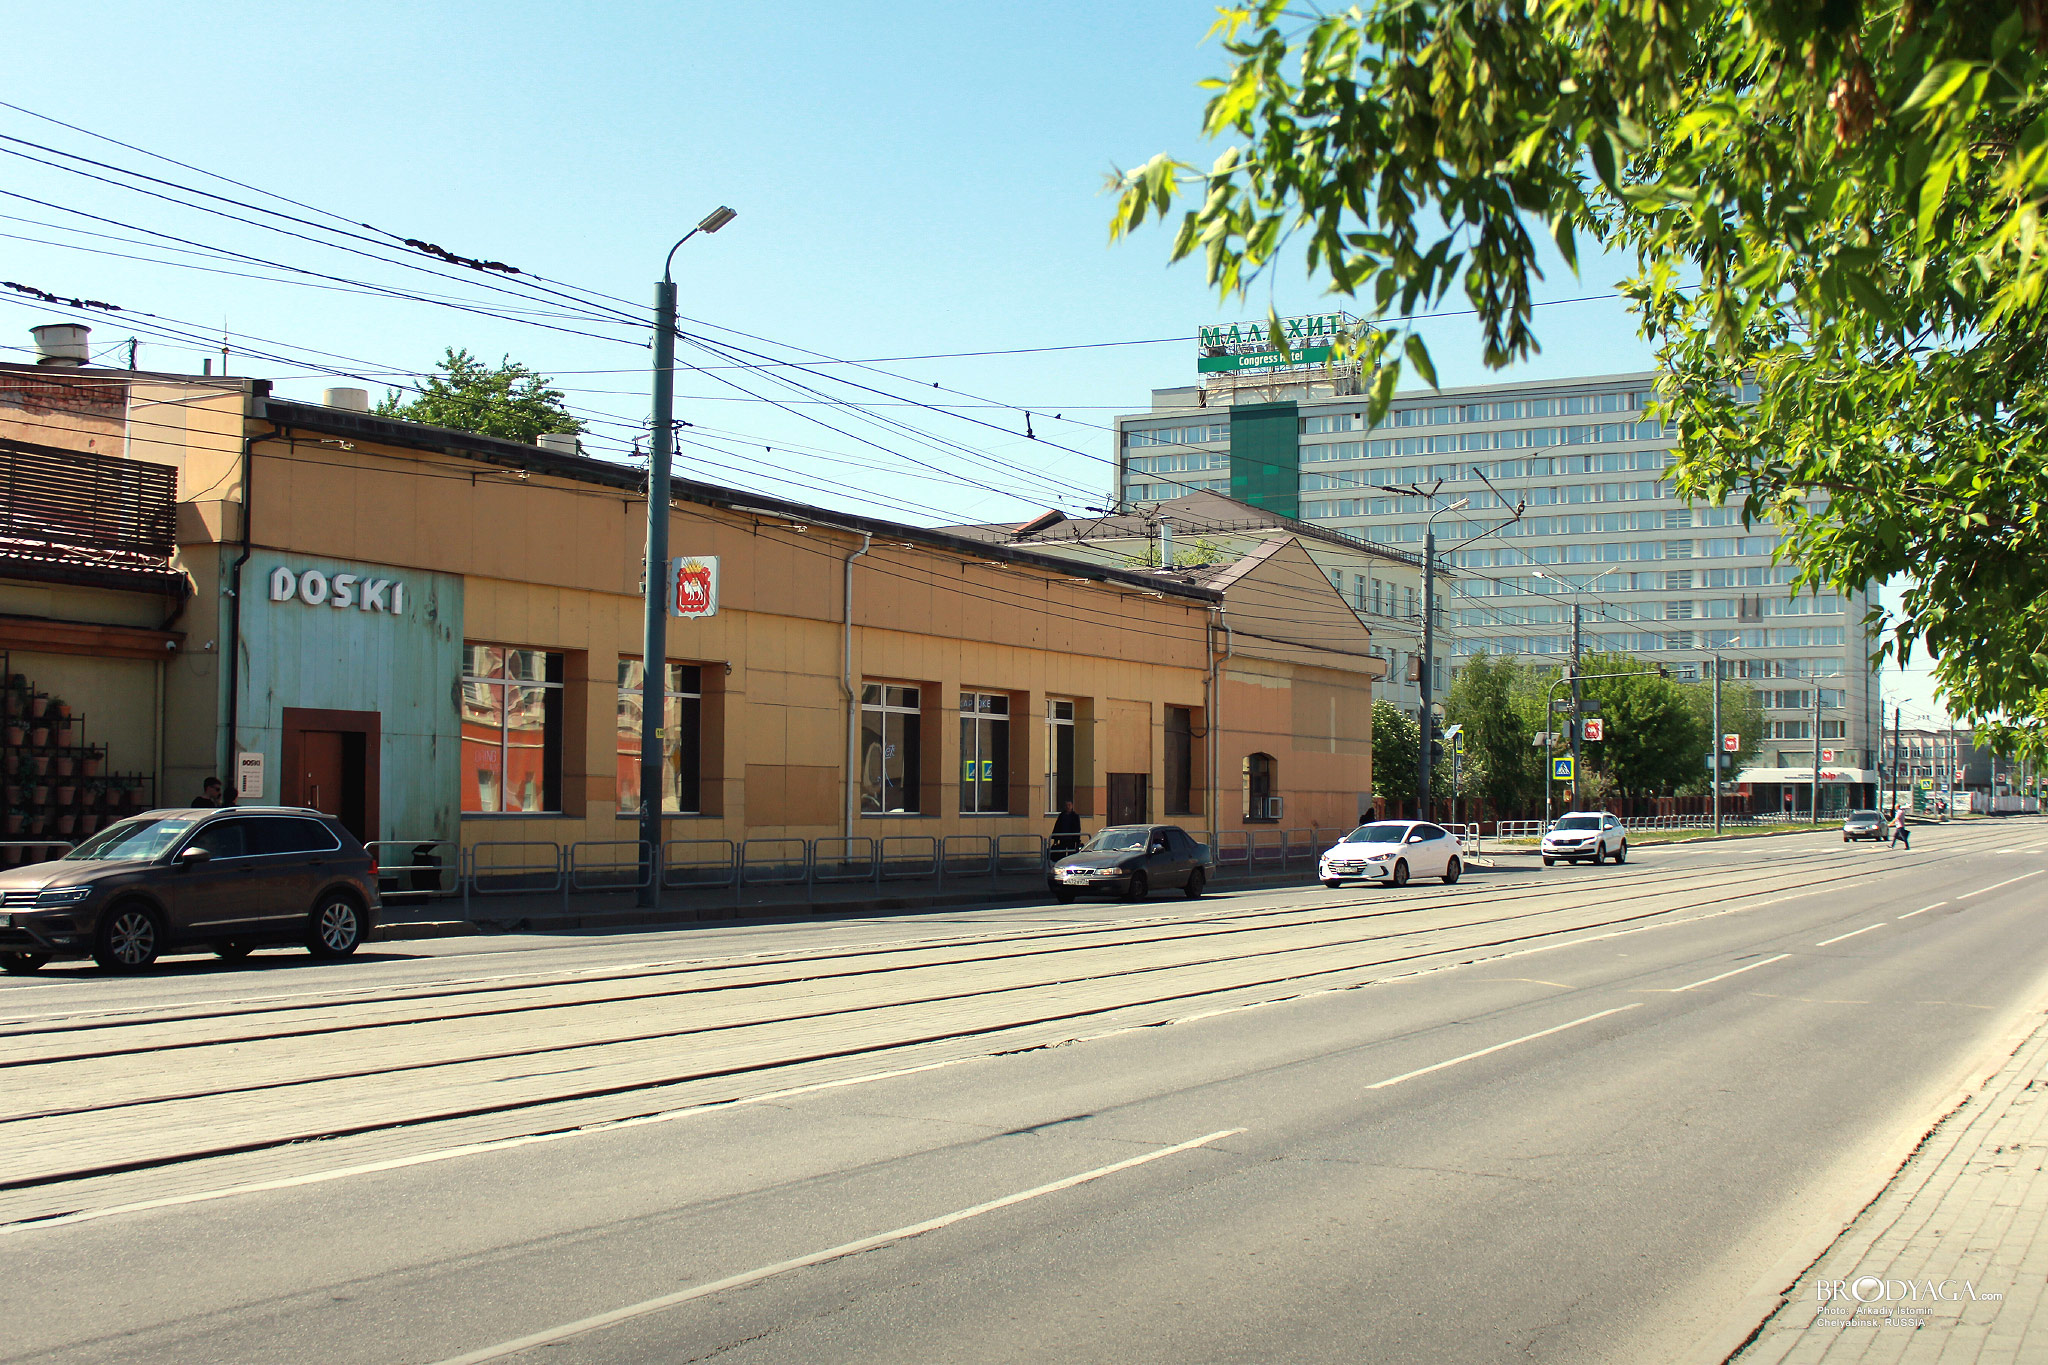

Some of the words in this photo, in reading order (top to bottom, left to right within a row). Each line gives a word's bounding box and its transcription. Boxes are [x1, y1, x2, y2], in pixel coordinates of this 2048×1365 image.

[1200, 315, 1341, 347] МАЛХИТ
[1239, 354, 1278, 366] Congress
[1280, 351, 1303, 362] Htel
[270, 566, 403, 615] DOSKI
